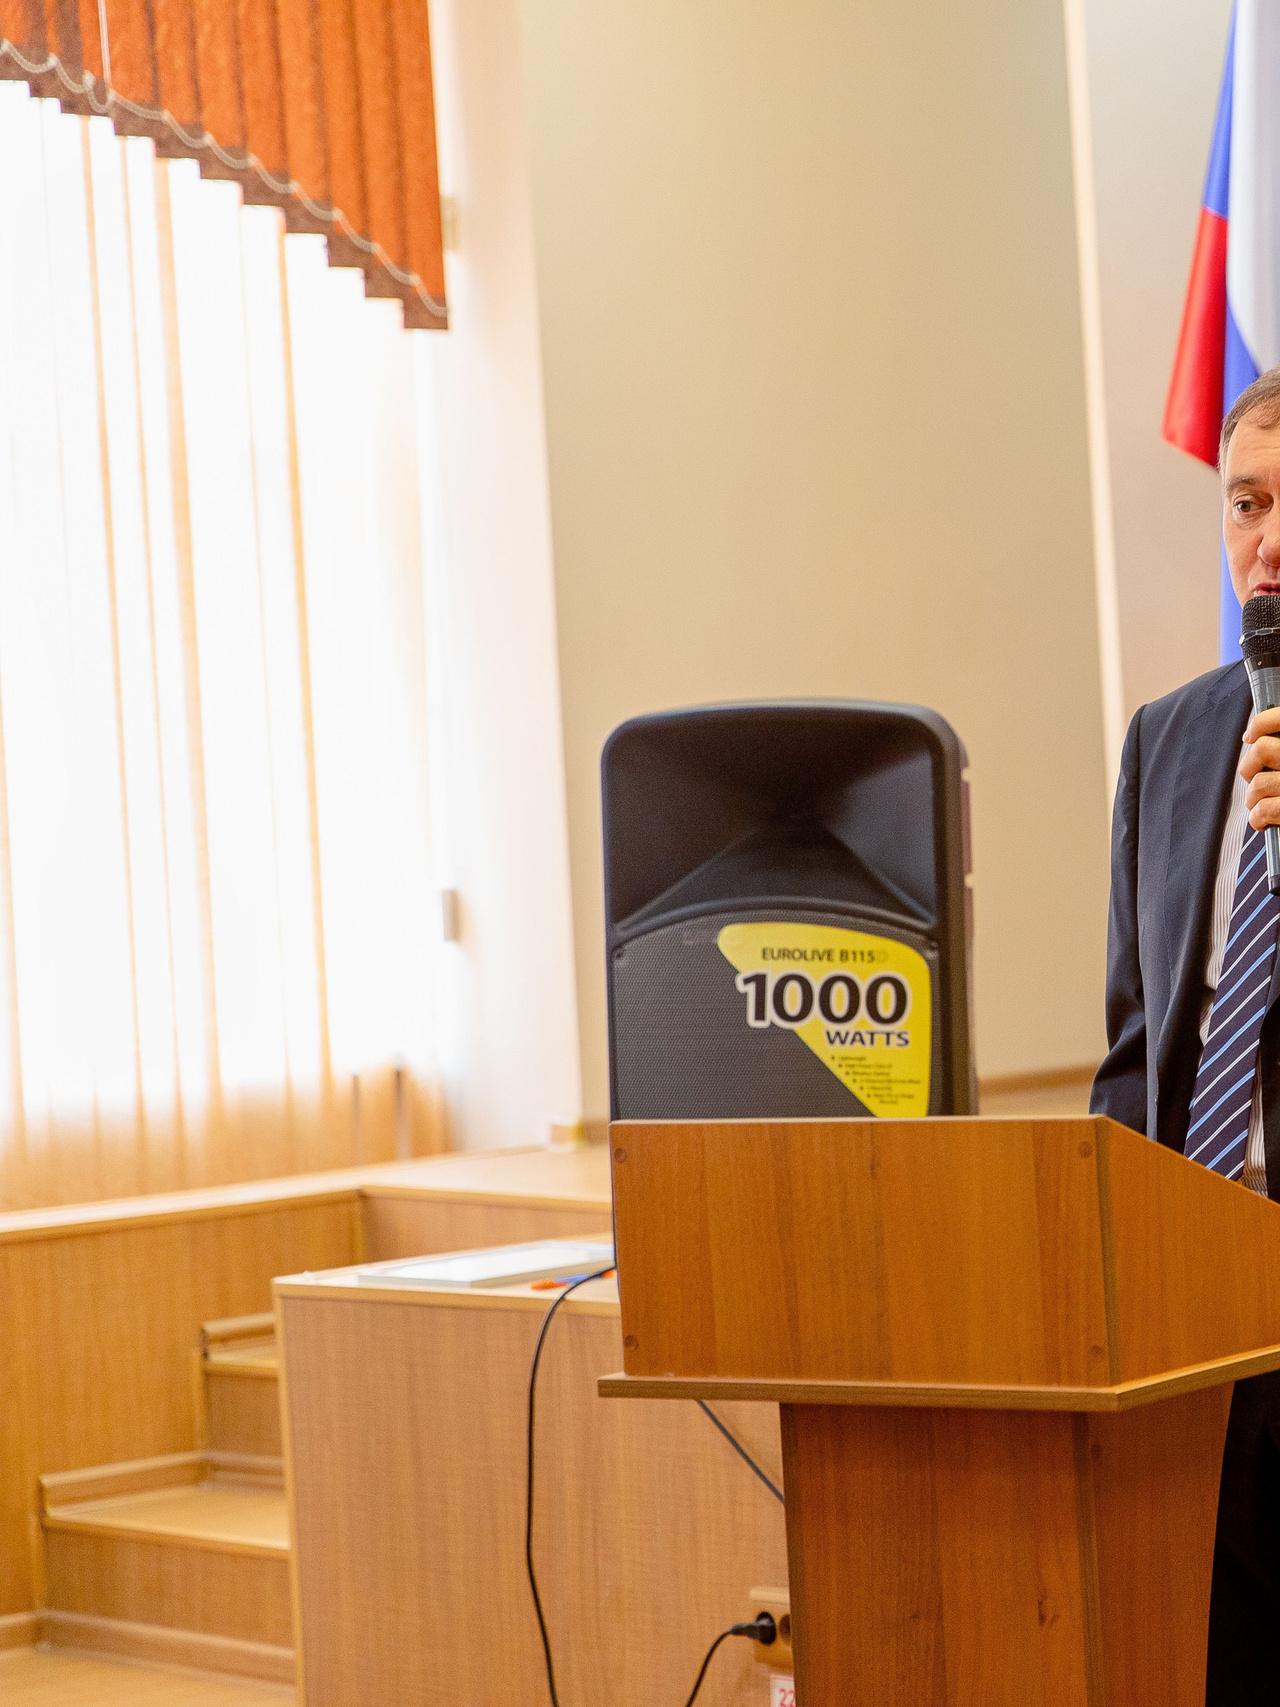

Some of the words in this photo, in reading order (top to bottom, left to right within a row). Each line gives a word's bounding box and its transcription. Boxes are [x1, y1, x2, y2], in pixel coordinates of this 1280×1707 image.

[761, 947, 834, 963] EUROLIVE
[742, 972, 908, 1025] 1000
[825, 1030, 910, 1047] WATTS
